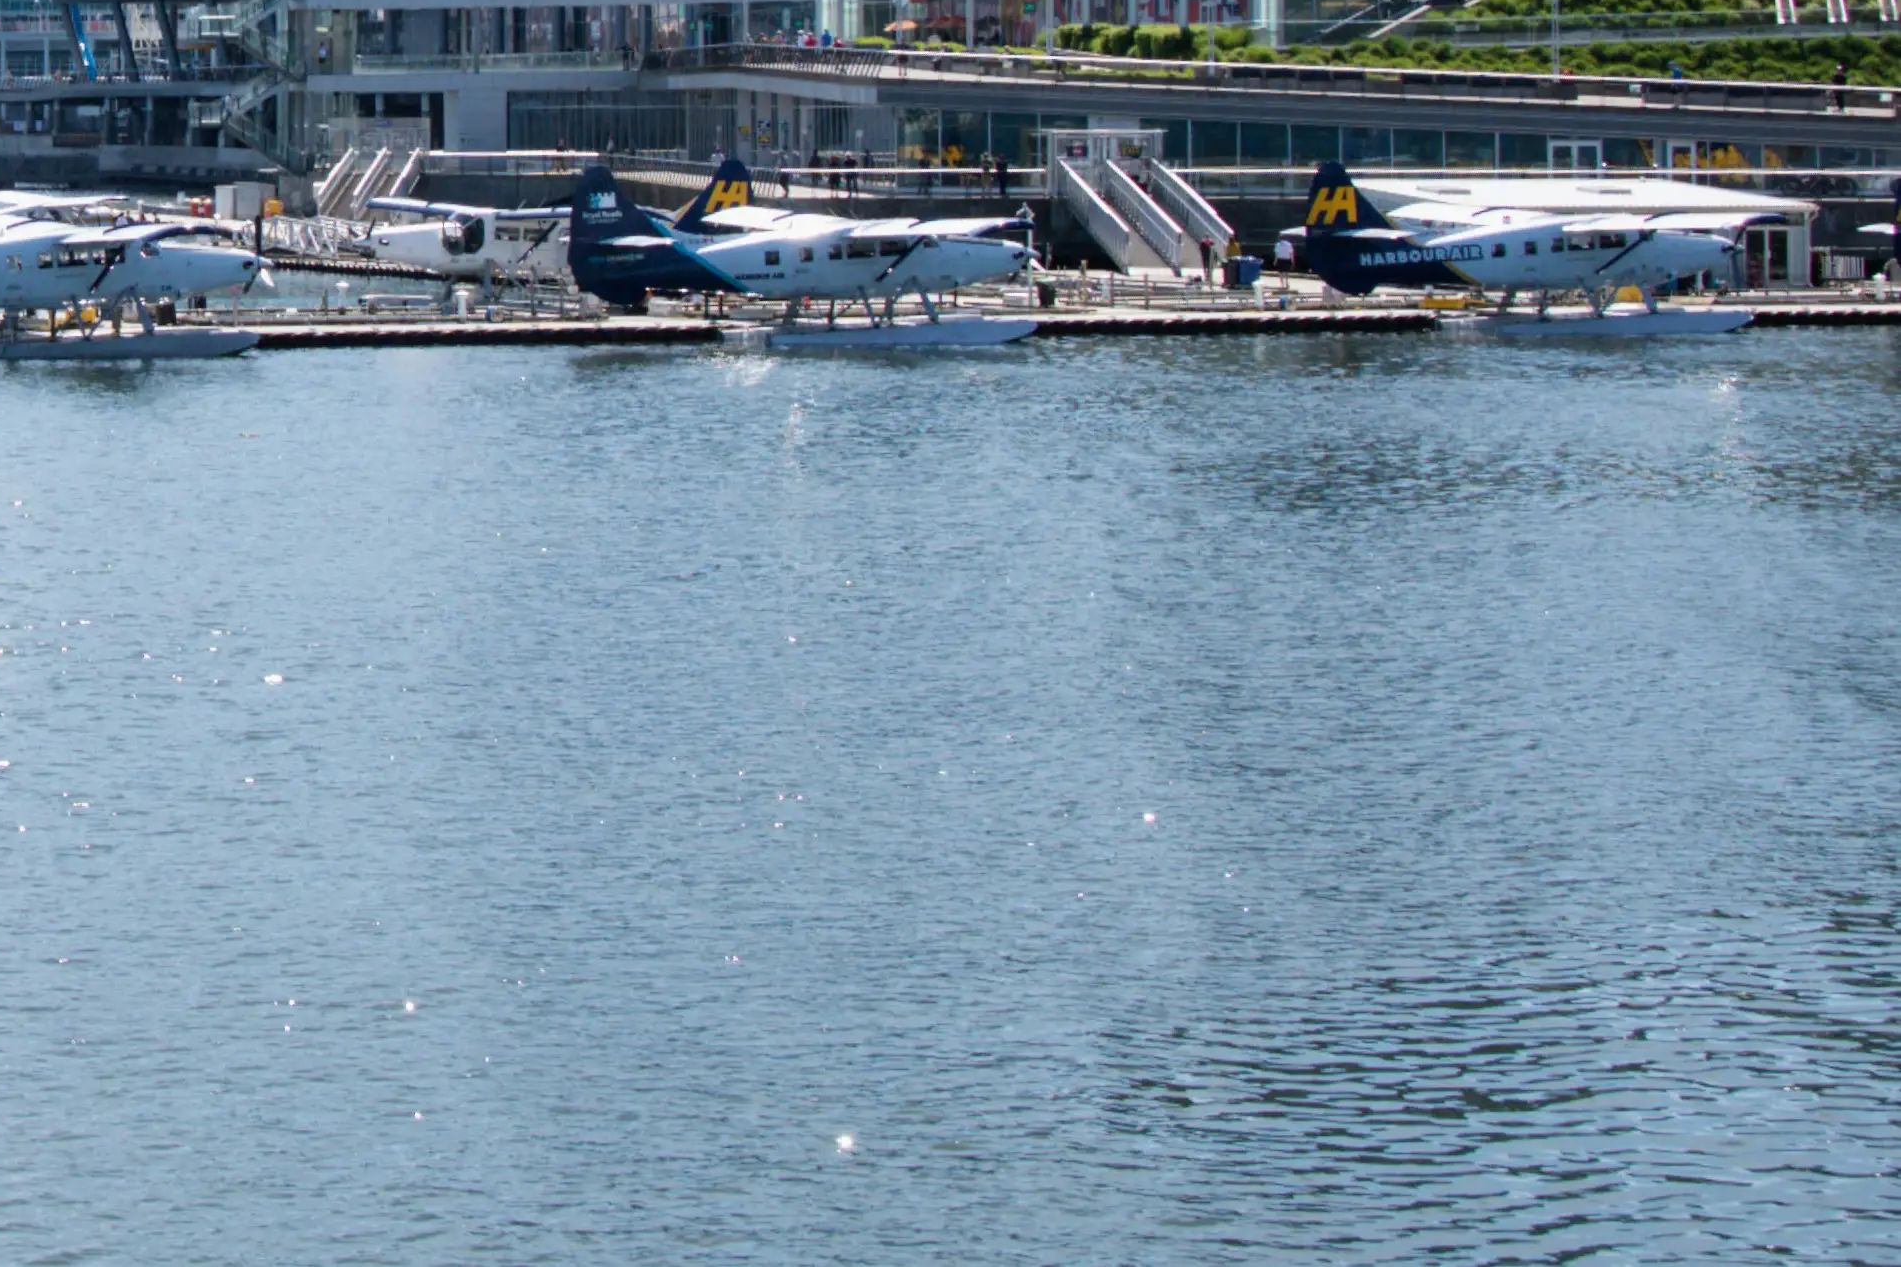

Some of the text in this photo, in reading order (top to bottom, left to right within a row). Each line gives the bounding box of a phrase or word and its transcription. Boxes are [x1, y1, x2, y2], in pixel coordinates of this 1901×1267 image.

[704, 179, 749, 214] HA
[1305, 185, 1359, 226] HA
[1358, 243, 1484, 267] HARBOUR AIR
